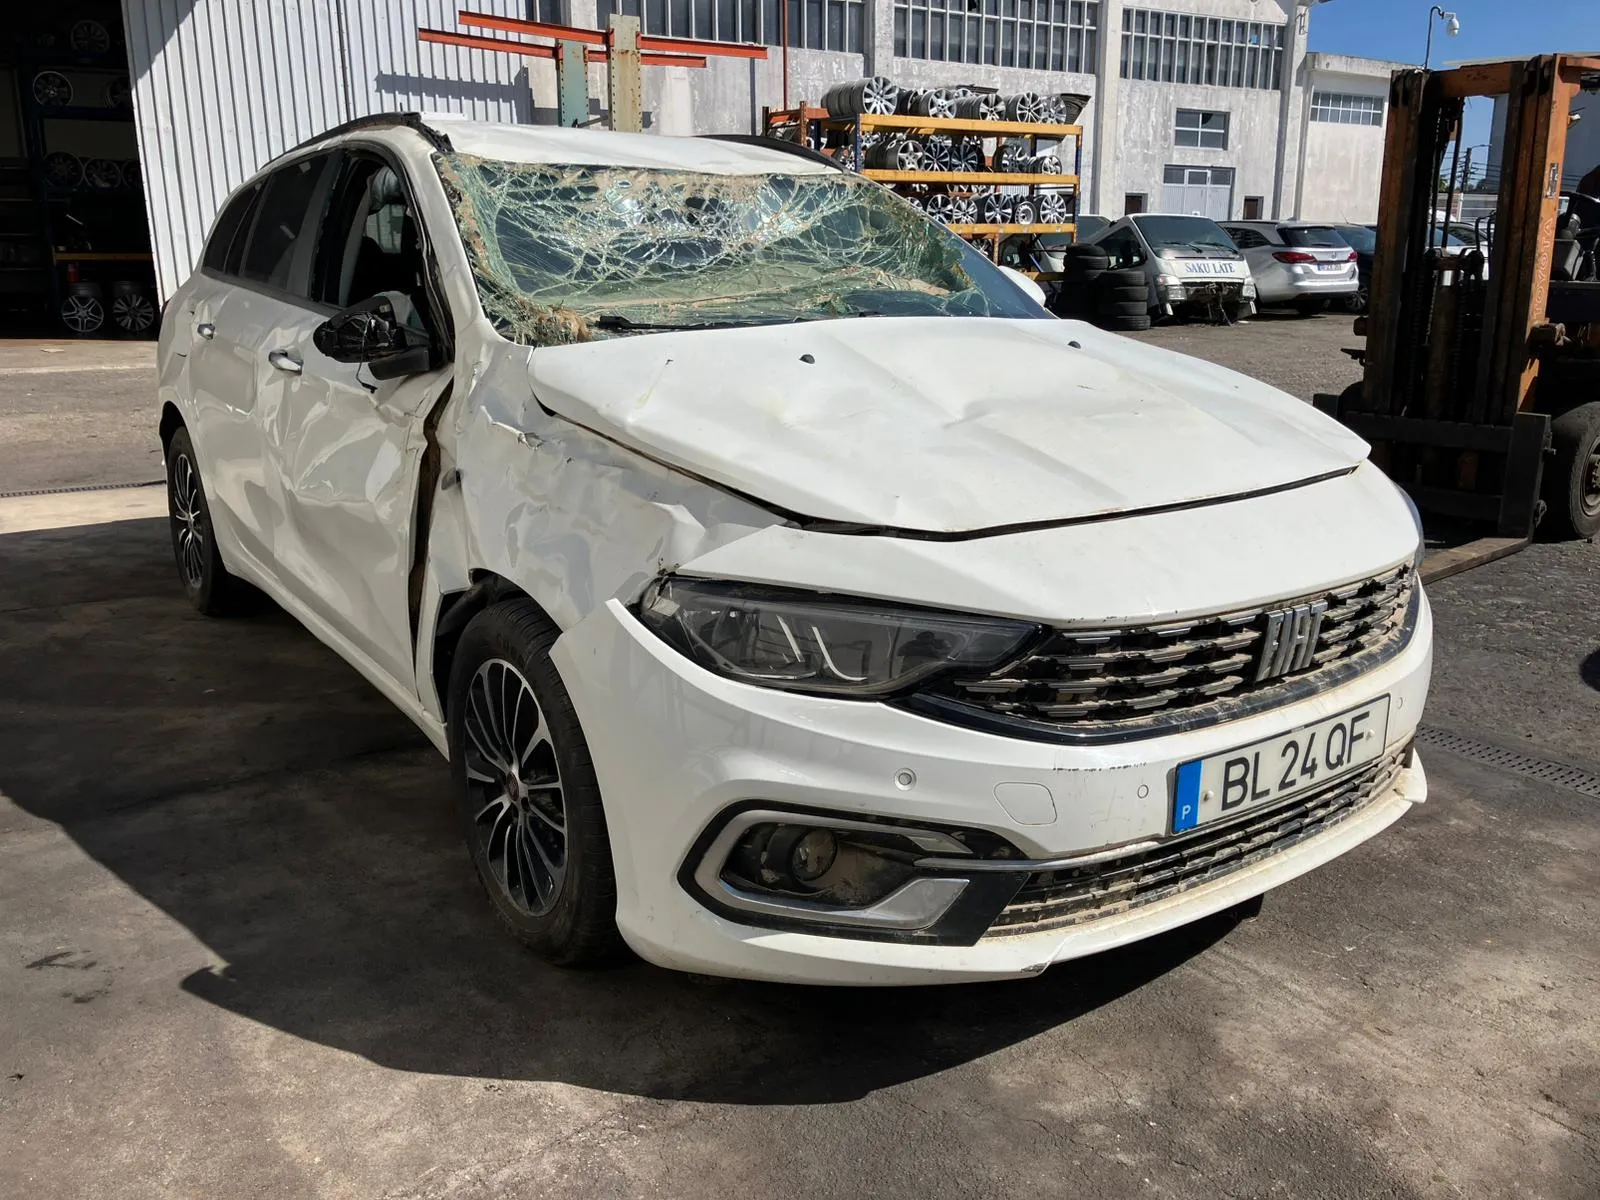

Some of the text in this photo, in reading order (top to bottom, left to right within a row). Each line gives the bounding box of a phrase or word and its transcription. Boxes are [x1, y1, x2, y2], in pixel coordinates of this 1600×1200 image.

[1185, 262, 1211, 274] SAKU
[1533, 217, 1553, 319] TOYOTA
[1221, 711, 1370, 811] BL 24 QF
[1182, 804, 1191, 820] P
